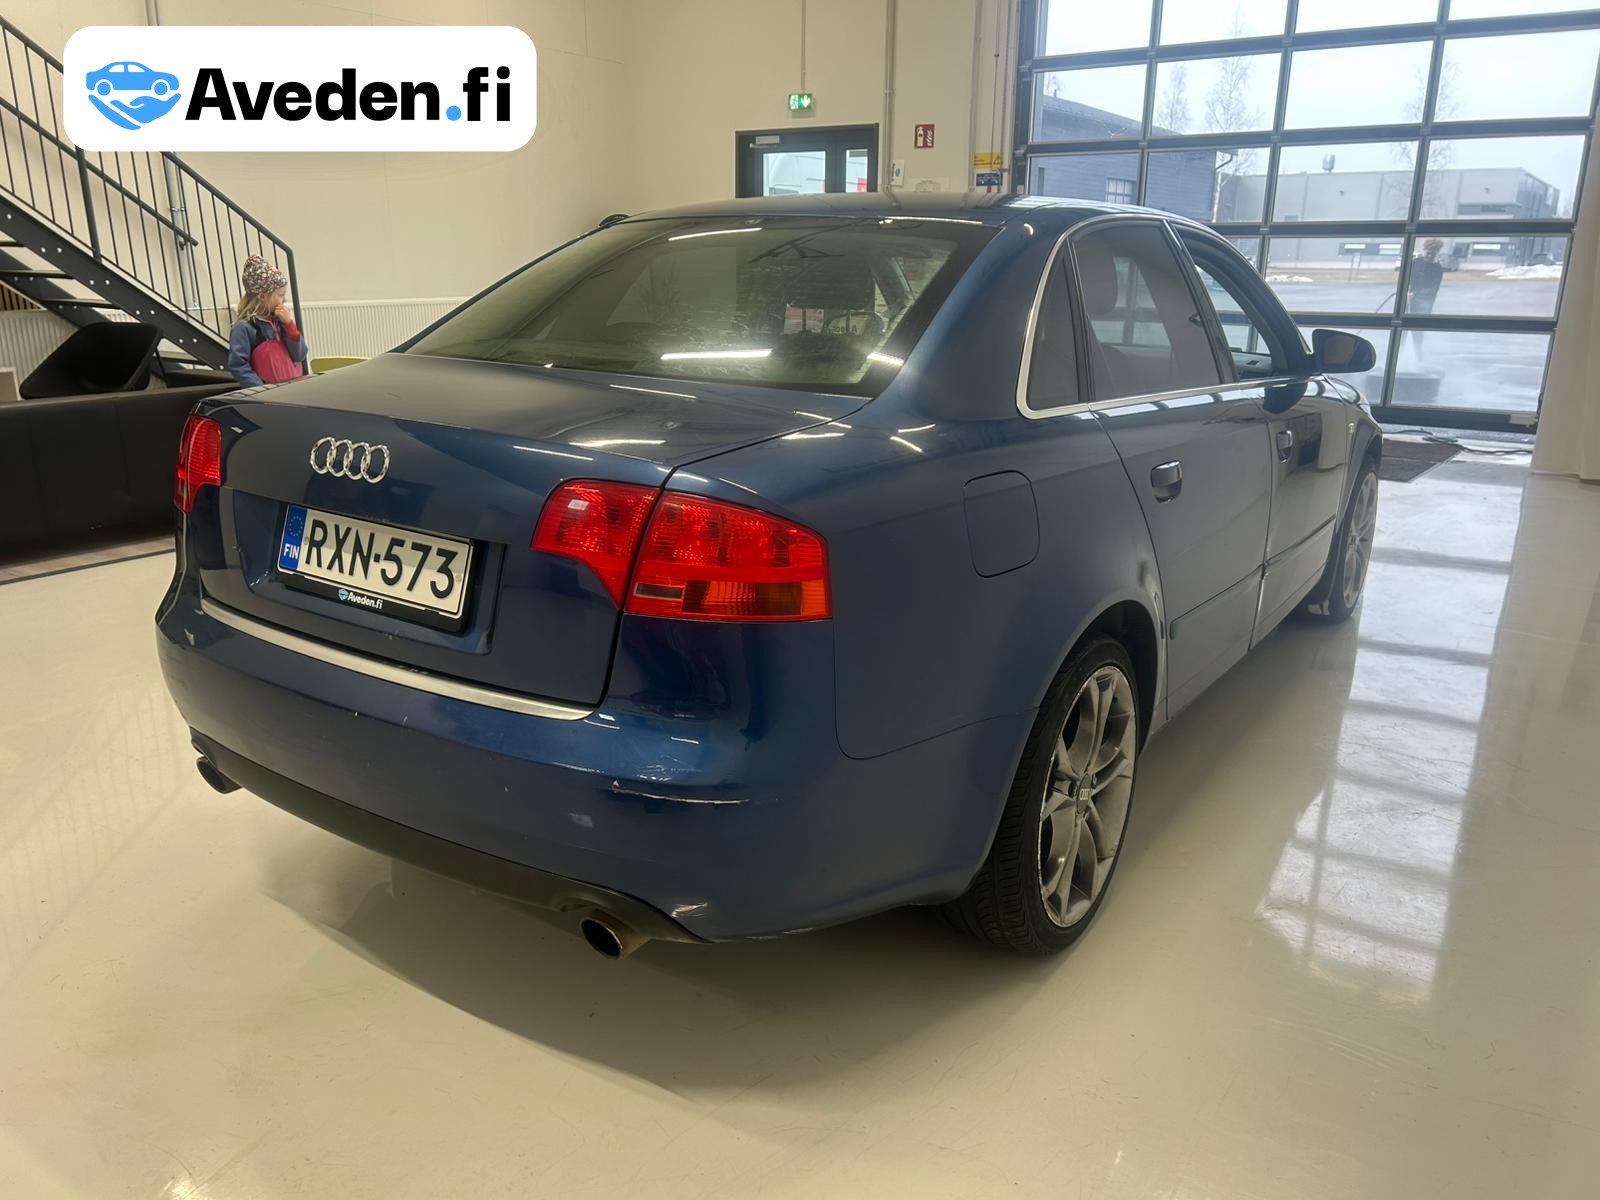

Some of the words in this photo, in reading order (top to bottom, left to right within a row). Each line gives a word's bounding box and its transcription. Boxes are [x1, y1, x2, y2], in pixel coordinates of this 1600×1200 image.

[283, 543, 299, 560] FIN
[305, 519, 458, 599] RXN-573
[347, 591, 383, 609] Aveden.fi
